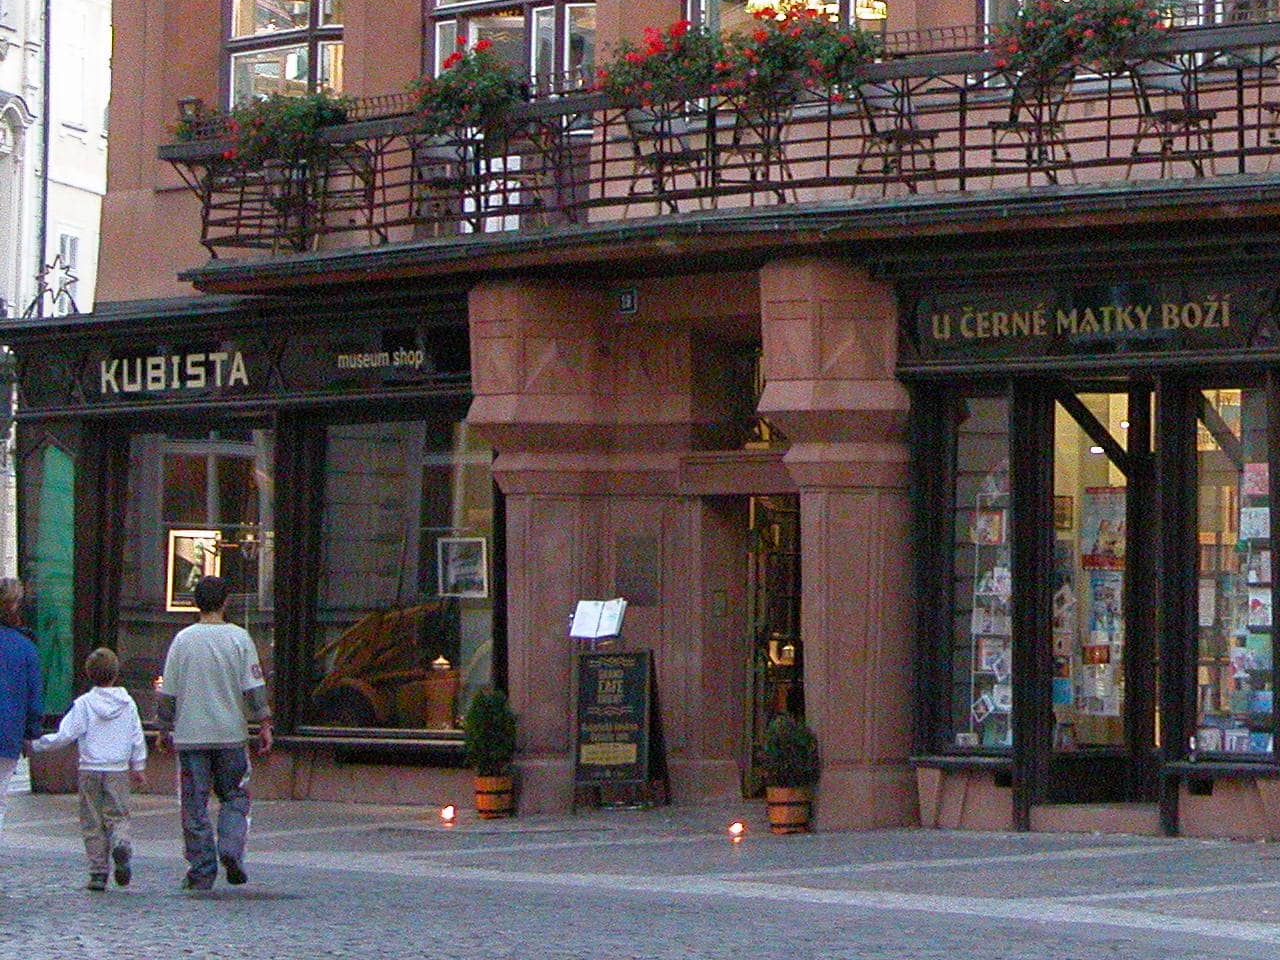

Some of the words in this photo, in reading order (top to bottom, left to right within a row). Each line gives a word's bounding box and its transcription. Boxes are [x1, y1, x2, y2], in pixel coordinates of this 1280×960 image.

[932, 313, 950, 340] U
[959, 302, 1048, 339] ČERNÉ
[1056, 304, 1153, 335] MATKY
[1161, 293, 1232, 330] BOŽÍ
[101, 352, 250, 393] KUBISTA
[337, 352, 389, 370] museum
[393, 349, 424, 371] shop
